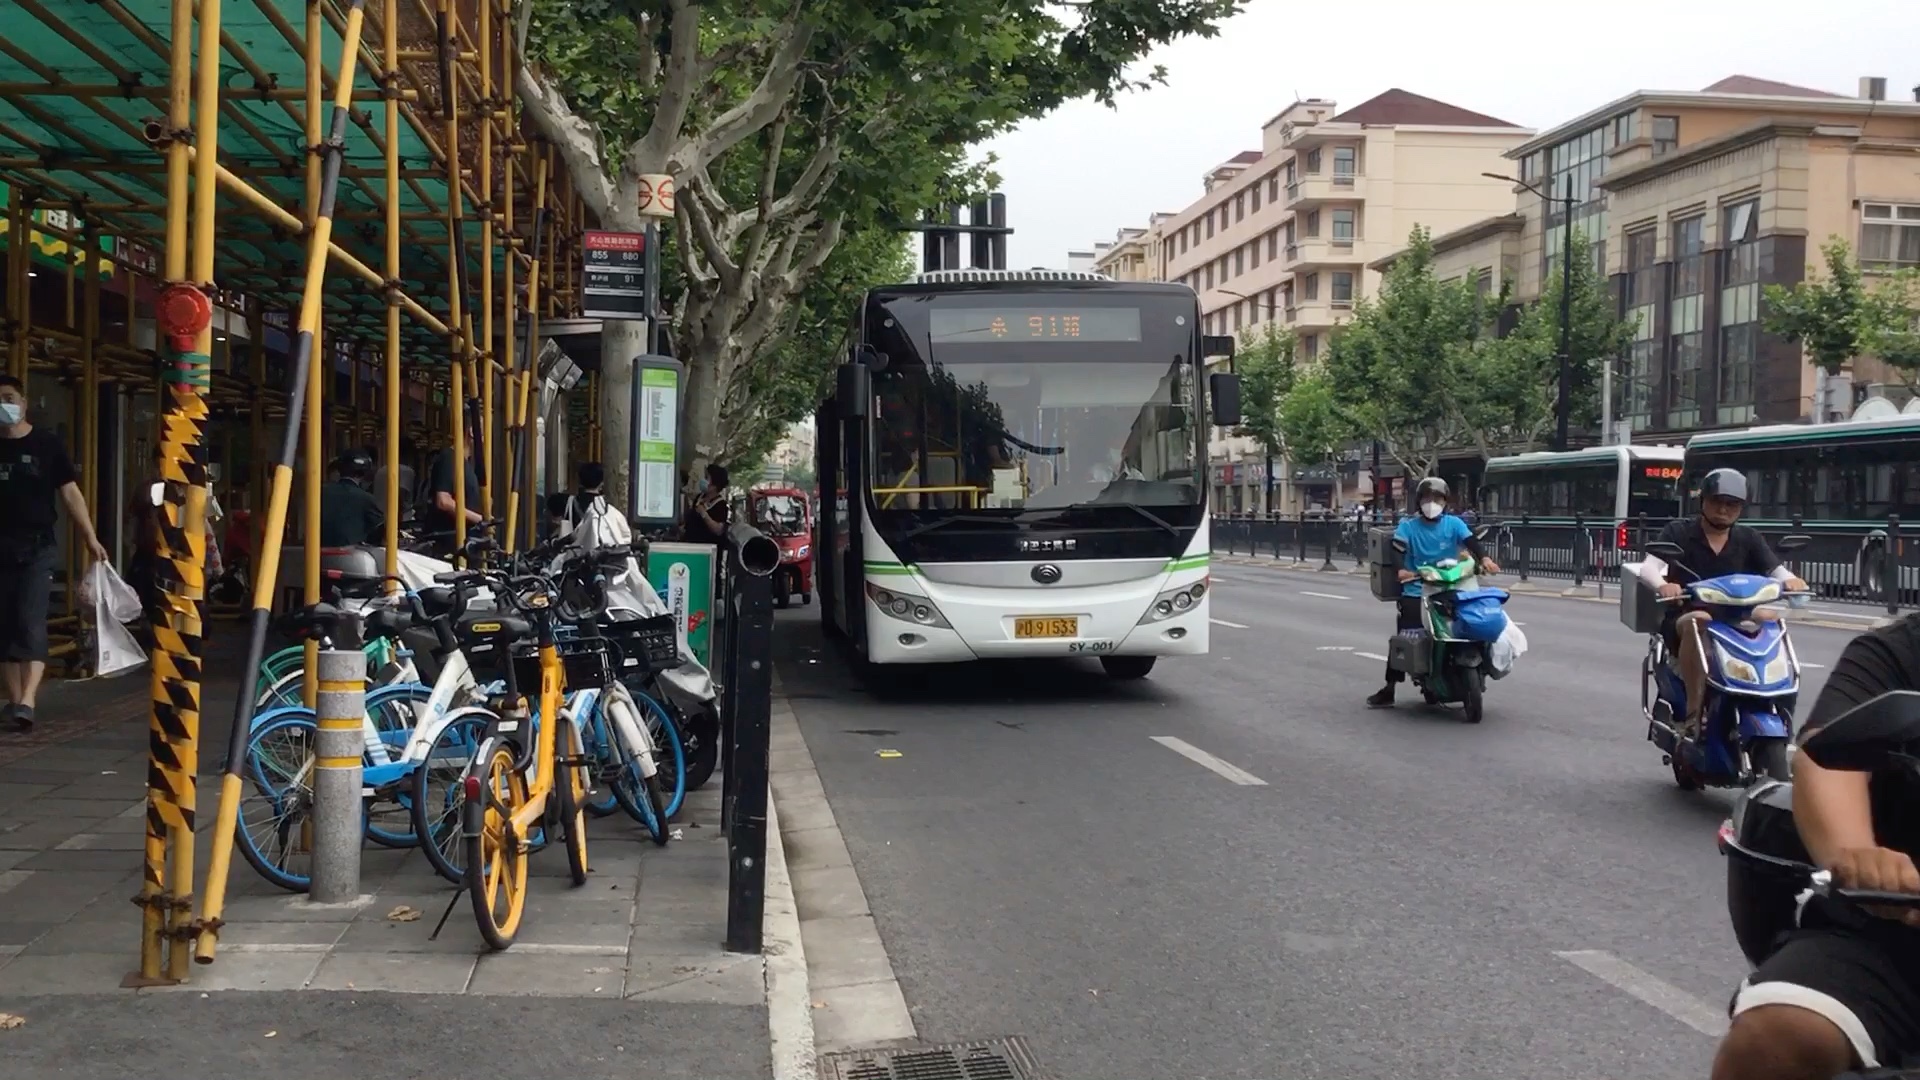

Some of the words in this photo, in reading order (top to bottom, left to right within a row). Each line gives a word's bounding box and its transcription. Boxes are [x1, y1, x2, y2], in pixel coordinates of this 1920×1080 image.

[592, 250, 609, 259] 855
[624, 275, 634, 283] 91
[1069, 641, 1113, 653] SY-001
